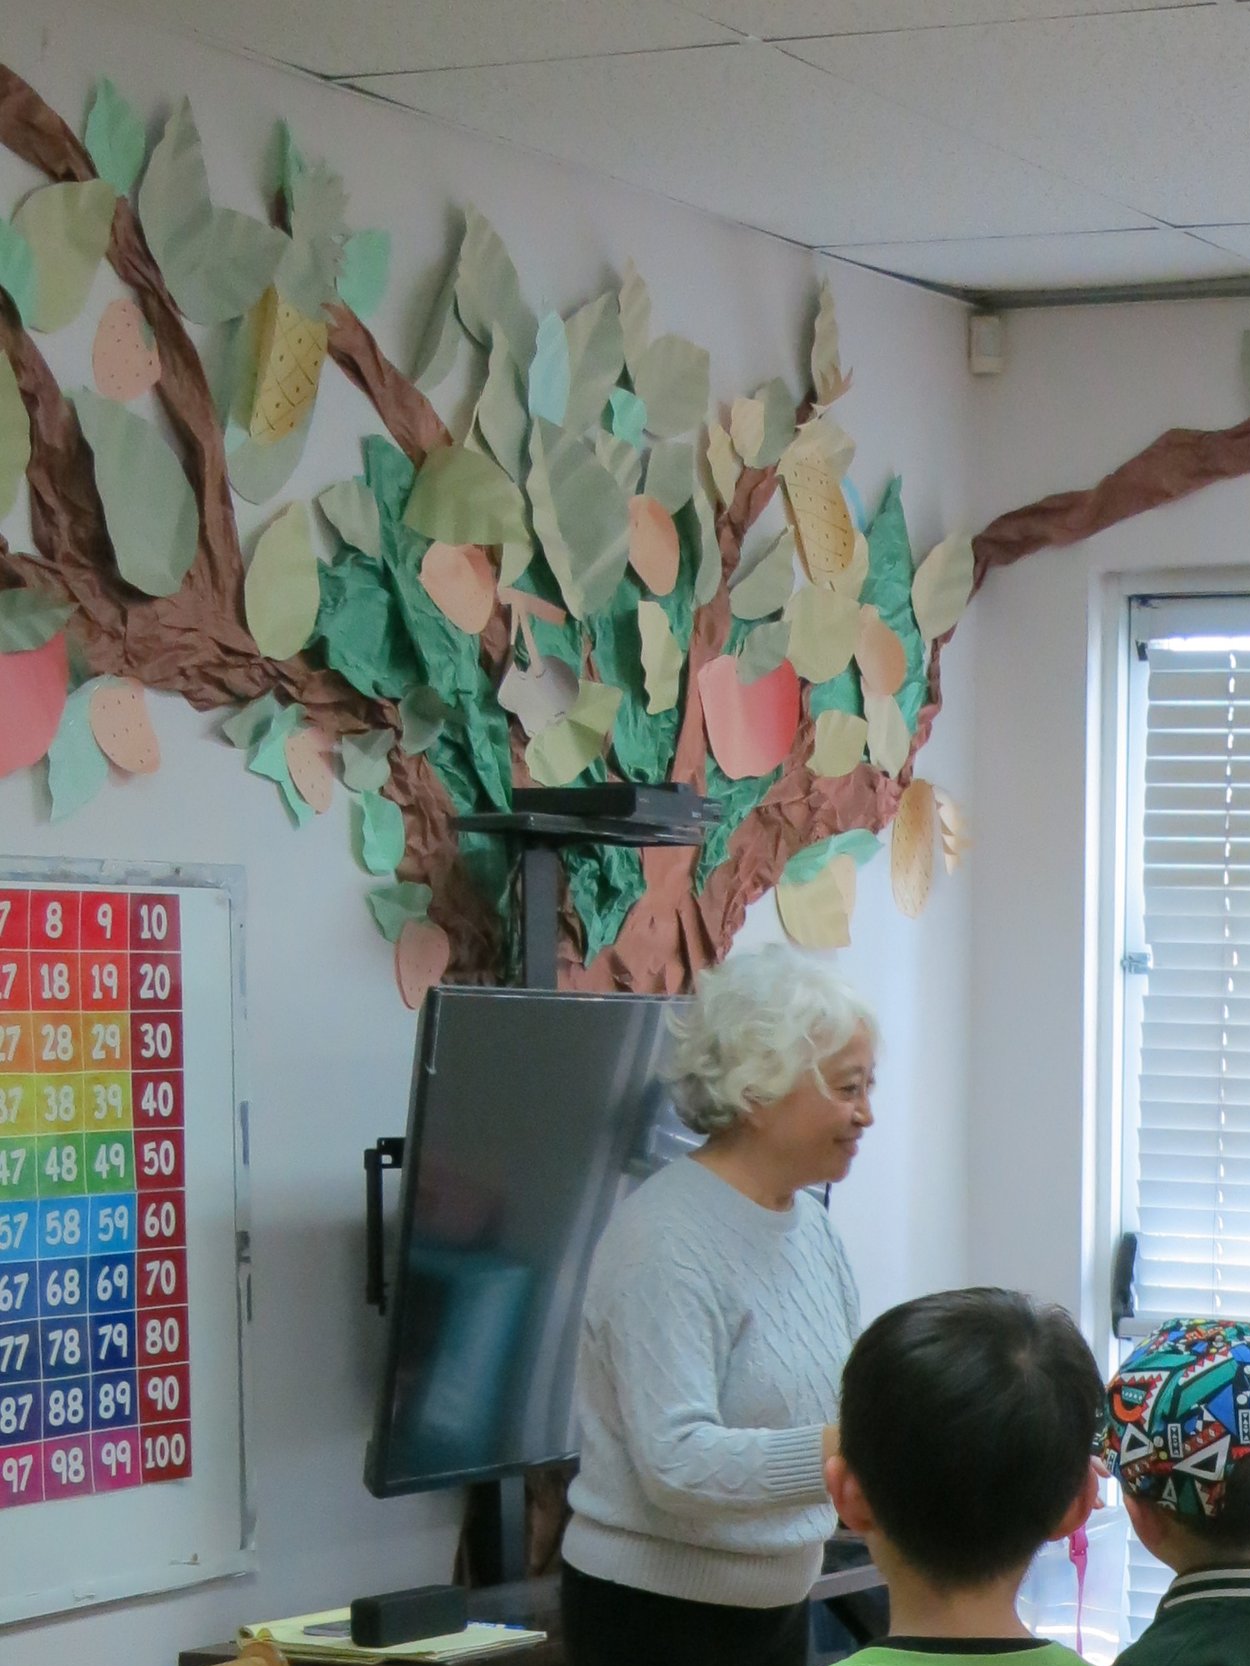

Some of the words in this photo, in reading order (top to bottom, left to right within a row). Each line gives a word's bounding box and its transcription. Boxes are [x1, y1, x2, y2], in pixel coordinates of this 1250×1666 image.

[0, 901, 11, 938] 7
[46, 902, 63, 939] 8
[97, 903, 113, 939] 9
[140, 904, 168, 940] 10
[0, 963, 17, 999] 7
[40, 963, 70, 1000] 18
[91, 964, 118, 1000] 19
[140, 963, 171, 1001] 20
[41, 1024, 74, 1061] 28
[91, 1023, 120, 1060] 29
[140, 1022, 173, 1059] 30
[44, 1085, 76, 1122] 38
[93, 1084, 122, 1120] 39
[141, 1081, 174, 1117] 40
[0, 1148, 26, 1186] 47
[45, 1145, 78, 1182] 48
[94, 1143, 125, 1179] 49
[143, 1140, 175, 1176] 50
[0, 1212, 29, 1250] 57
[46, 1208, 81, 1245] 58
[98, 1205, 129, 1242] 59
[144, 1201, 177, 1238] 60
[0, 1272, 29, 1312] 67
[46, 1268, 81, 1306] 68
[97, 1264, 129, 1302] 69
[146, 1260, 176, 1296] 70
[0, 1334, 30, 1373] 77
[48, 1328, 81, 1366] 78
[98, 1323, 128, 1360] 79
[145, 1317, 179, 1354] 80
[0, 1394, 33, 1434] 87
[48, 1387, 84, 1426] 88
[99, 1381, 131, 1419] 89
[147, 1375, 179, 1411] 90
[2, 1454, 33, 1493] 97
[51, 1447, 85, 1485] 98
[101, 1440, 131, 1477] 99
[144, 1433, 186, 1469] 100
